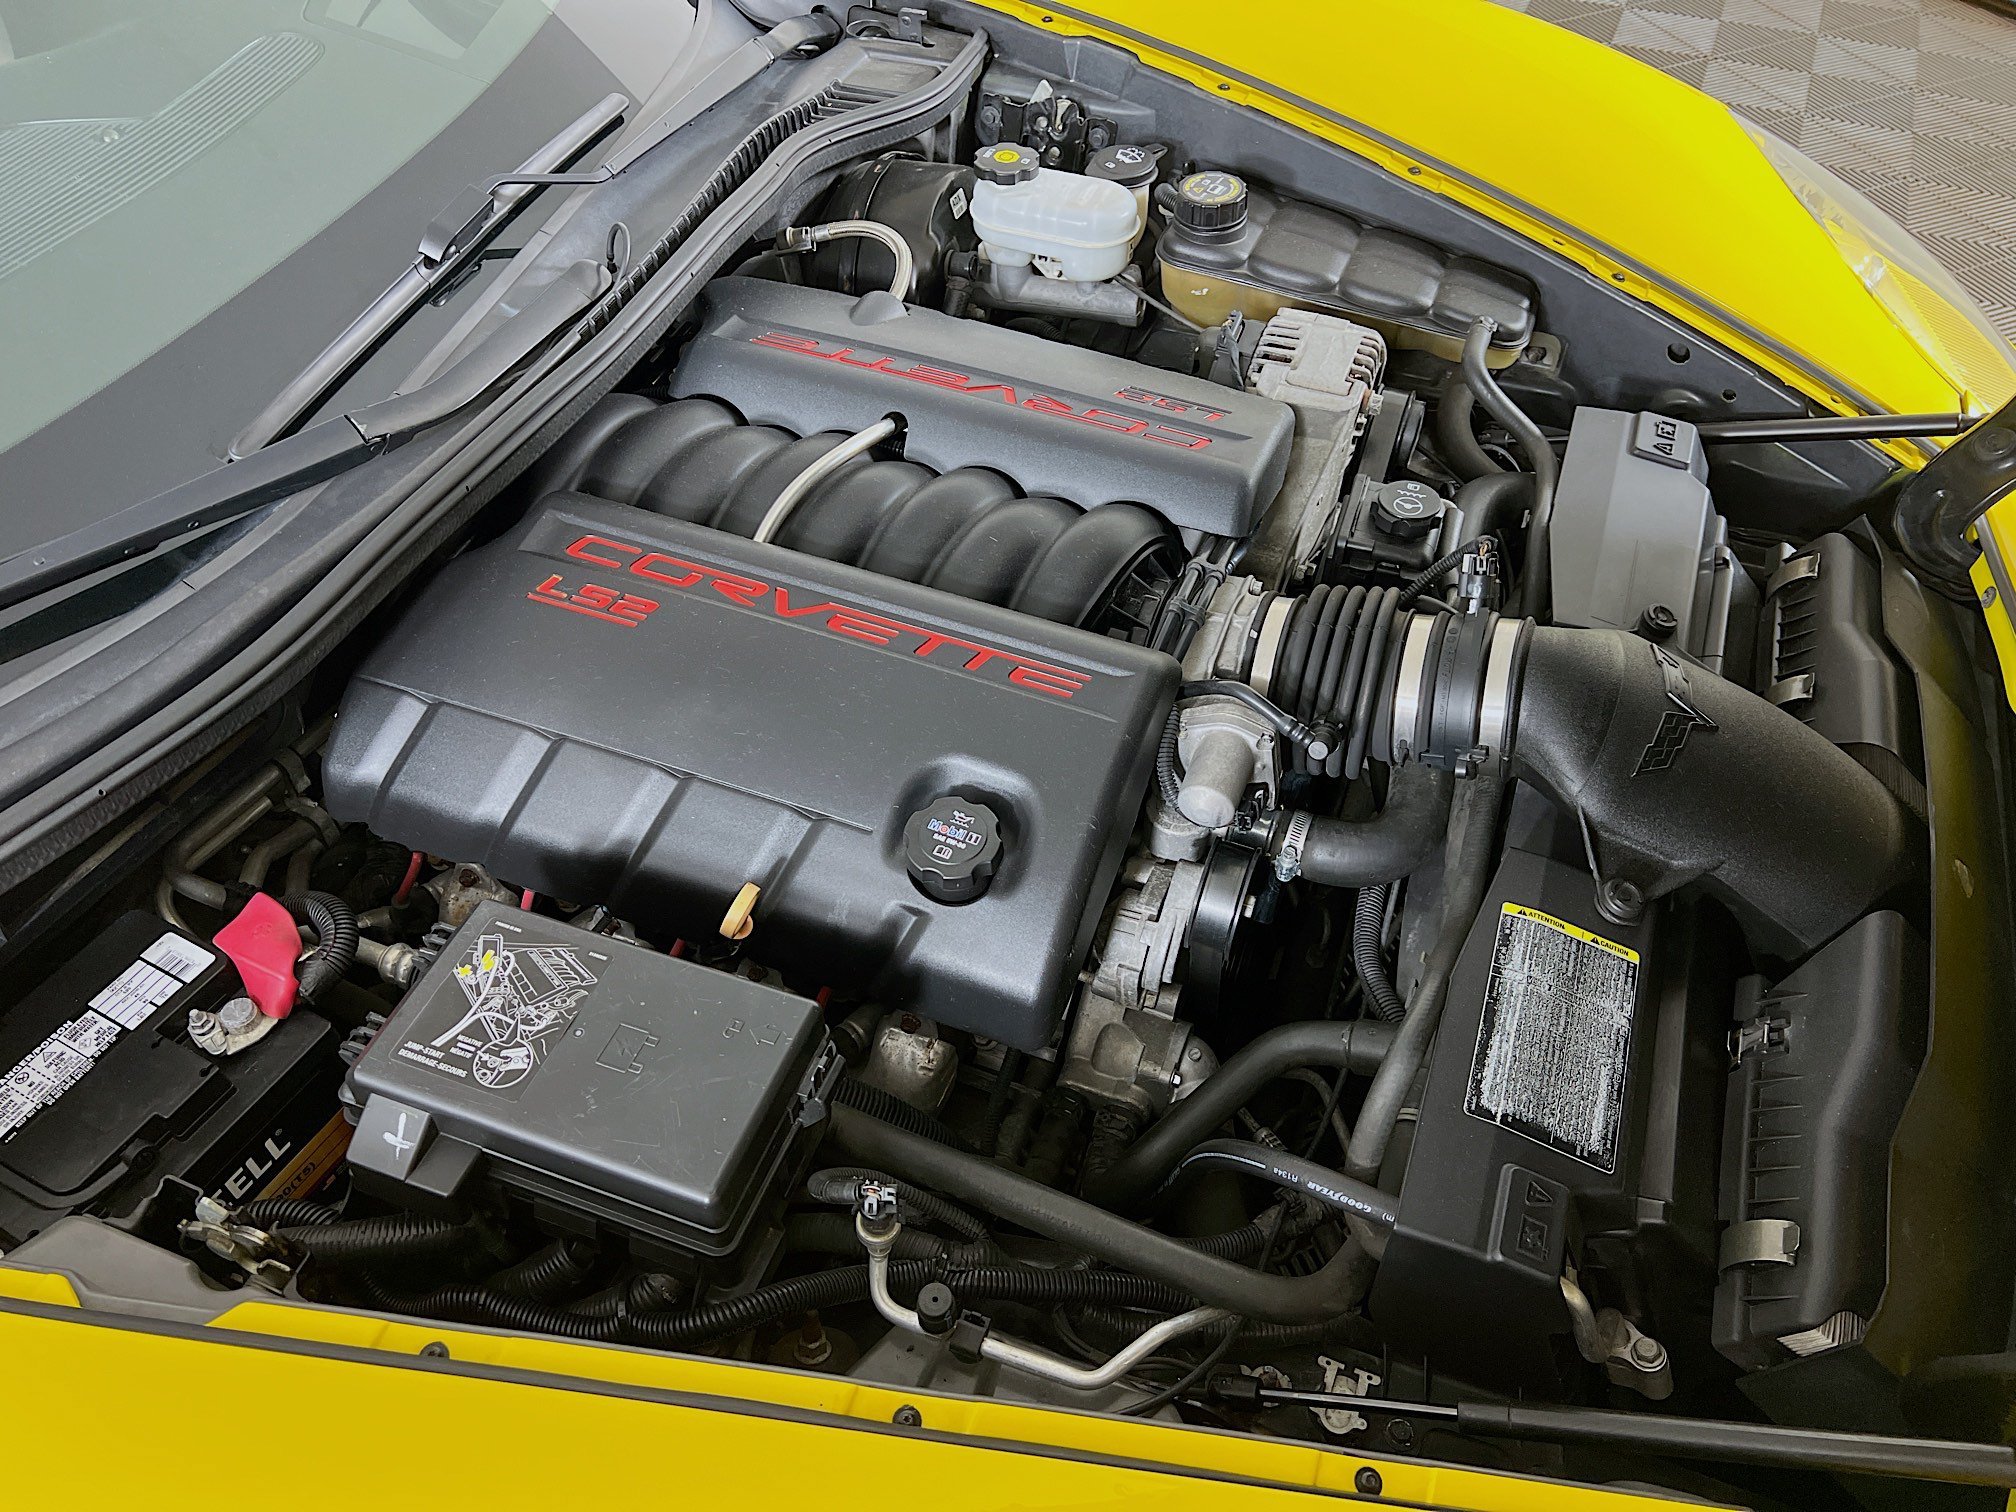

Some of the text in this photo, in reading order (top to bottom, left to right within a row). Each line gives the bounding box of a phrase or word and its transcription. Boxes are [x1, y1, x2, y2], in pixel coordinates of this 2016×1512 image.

[750, 331, 1213, 450] CORVETTE
[527, 574, 660, 627] LS2
[566, 535, 1092, 698] CORVETTE
[927, 818, 967, 840] Mobil
[1528, 911, 1566, 930] ATTENTION
[1600, 940, 1629, 957] CAUTION
[404, 1041, 445, 1059] JUMP-START
[457, 1034, 483, 1047] NEGATIVE
[0, 1021, 73, 1085] ANGER/POISON
[1273, 1167, 1299, 1183] R134a
[1307, 1182, 1371, 1212] GOODYEAR
